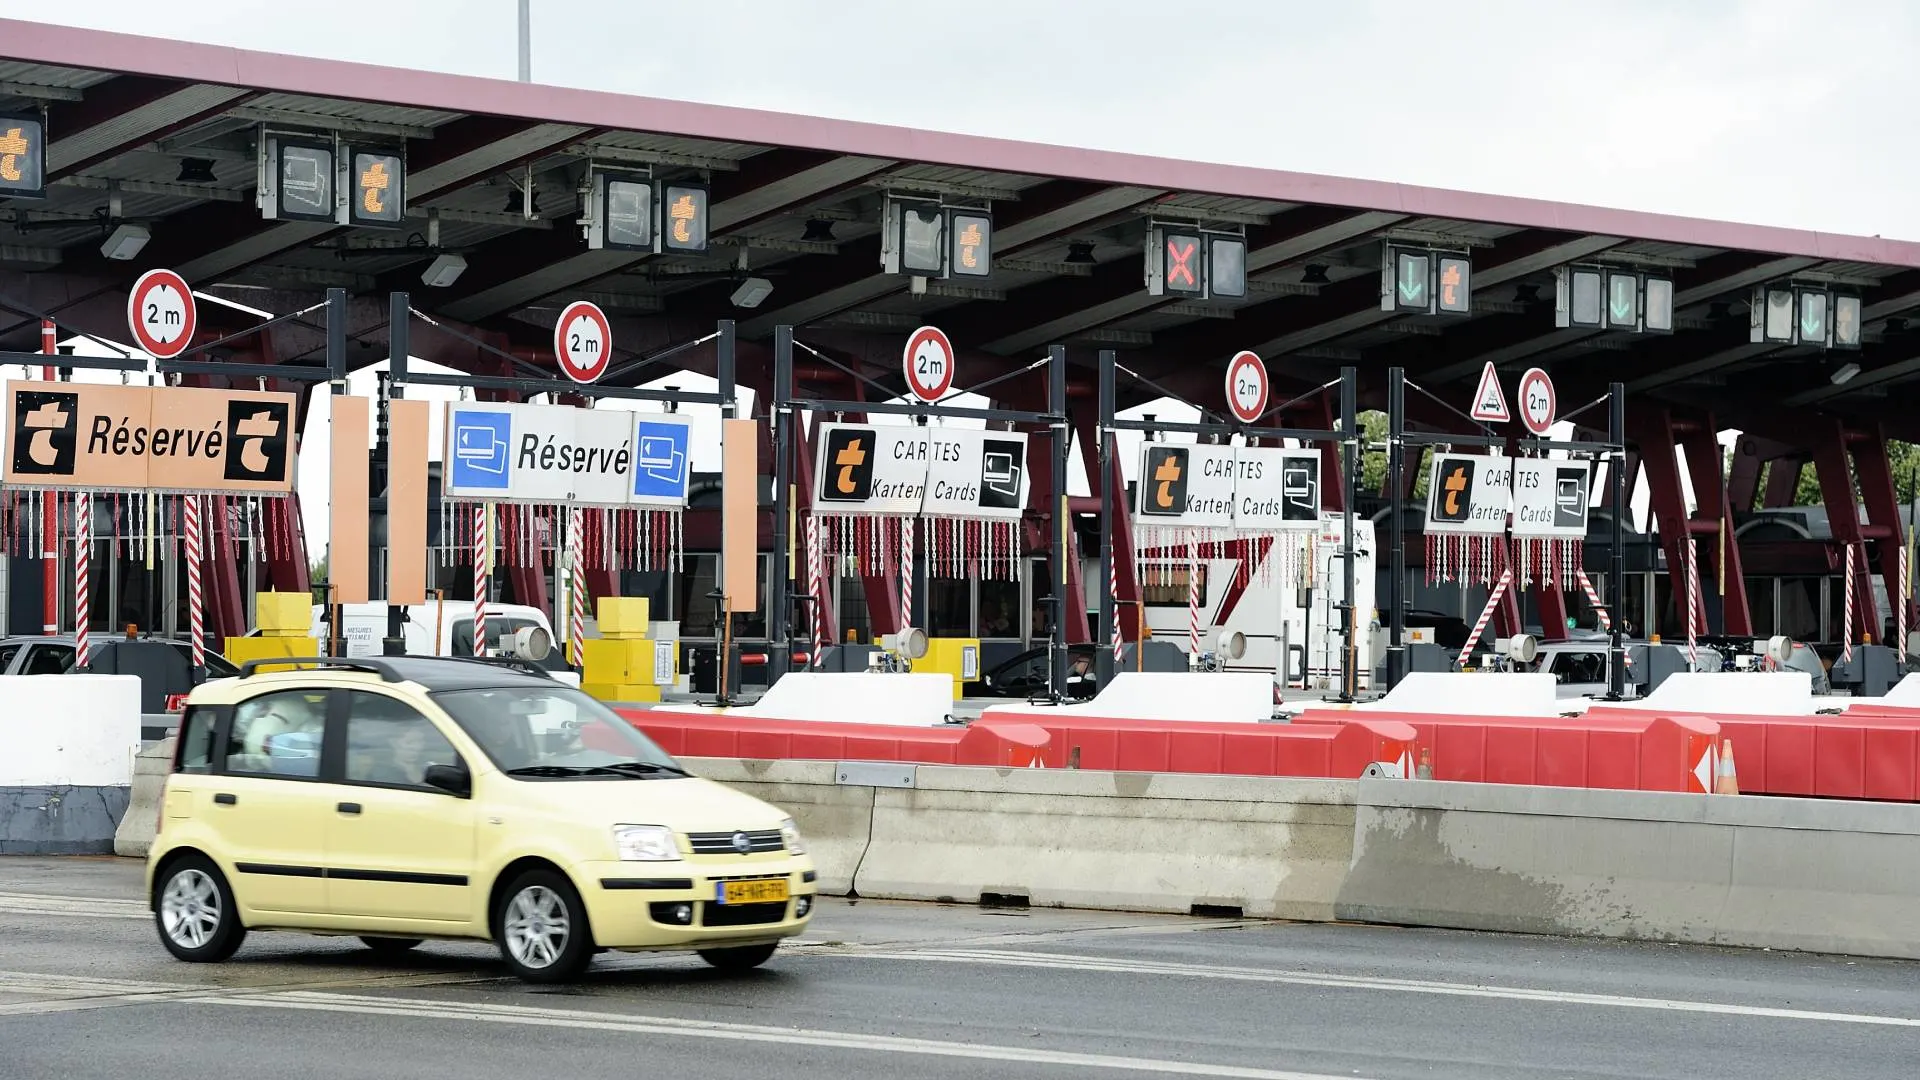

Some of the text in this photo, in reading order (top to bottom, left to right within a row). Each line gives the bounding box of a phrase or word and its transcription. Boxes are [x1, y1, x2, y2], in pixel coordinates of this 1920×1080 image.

[147, 304, 180, 325] 2 m
[571, 333, 598, 353] 2 m
[918, 355, 943, 375] 2 m
[1238, 379, 1258, 395] 2 m
[1530, 393, 1548, 410] 2 m
[88, 415, 223, 459] Réservé
[517, 433, 629, 474] Réservé
[893, 440, 961, 462] CARTES
[1203, 458, 1263, 479] CARTES
[1485, 469, 1540, 488] CARTES
[870, 479, 977, 501] Karten Cards
[1186, 494, 1280, 516] Karten Cards
[1469, 502, 1552, 522] Karten Cards
